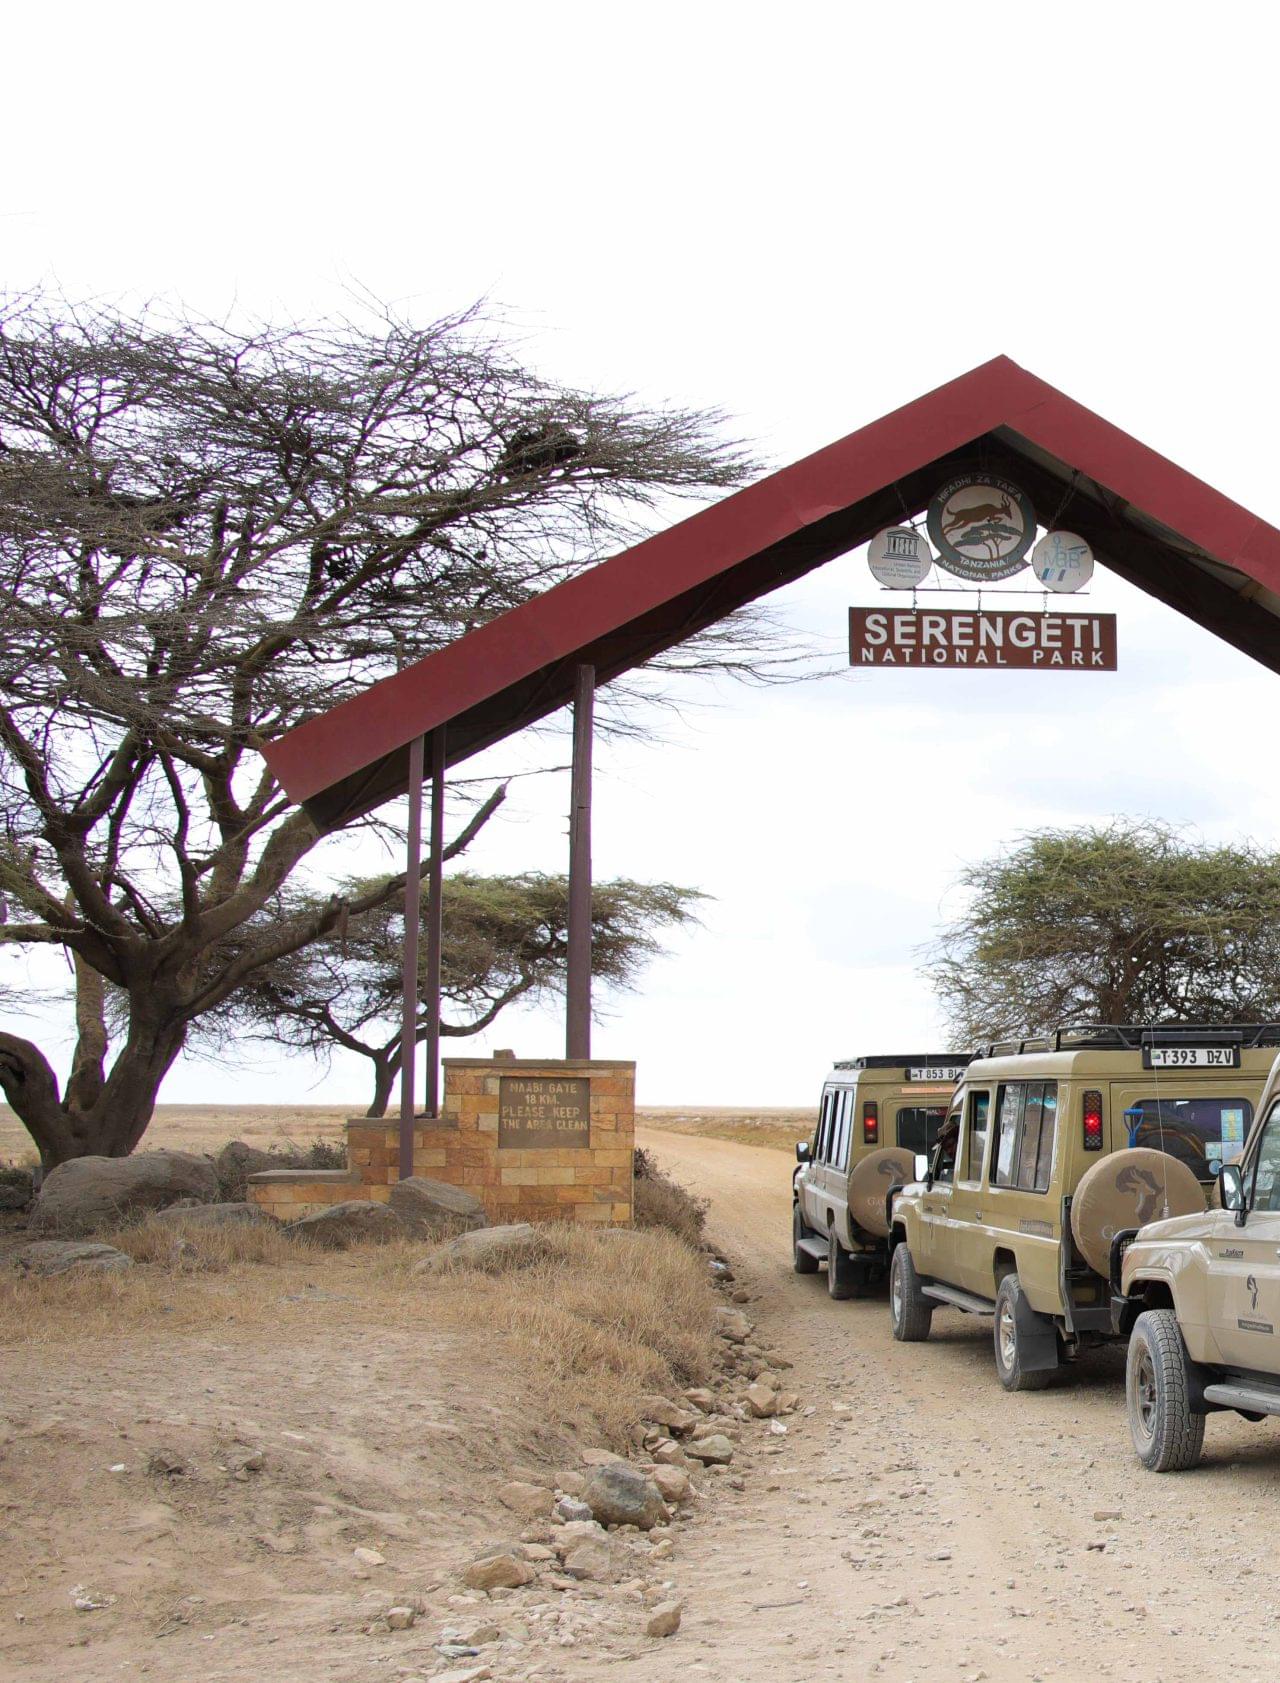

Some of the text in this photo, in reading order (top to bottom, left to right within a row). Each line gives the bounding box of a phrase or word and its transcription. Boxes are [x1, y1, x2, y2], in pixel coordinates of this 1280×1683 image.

[937, 475, 971, 502] HIFADHI
[976, 475, 991, 484] ZA
[942, 559, 1022, 579] NATIONAL PARKS
[960, 557, 1007, 569] TANZANIA
[864, 613, 1100, 649] SERENGETI
[861, 648, 1104, 665] NATIONAL PARK
[1160, 1050, 1232, 1064] T 393 DZV
[918, 1069, 923, 1079] T
[926, 1069, 944, 1079] 853
[549, 1083, 577, 1094] GATE
[525, 1094, 536, 1104] 18
[502, 1106, 580, 1118] PLEASE KEEP
[502, 1119, 588, 1130] THE AREA CLEAN
